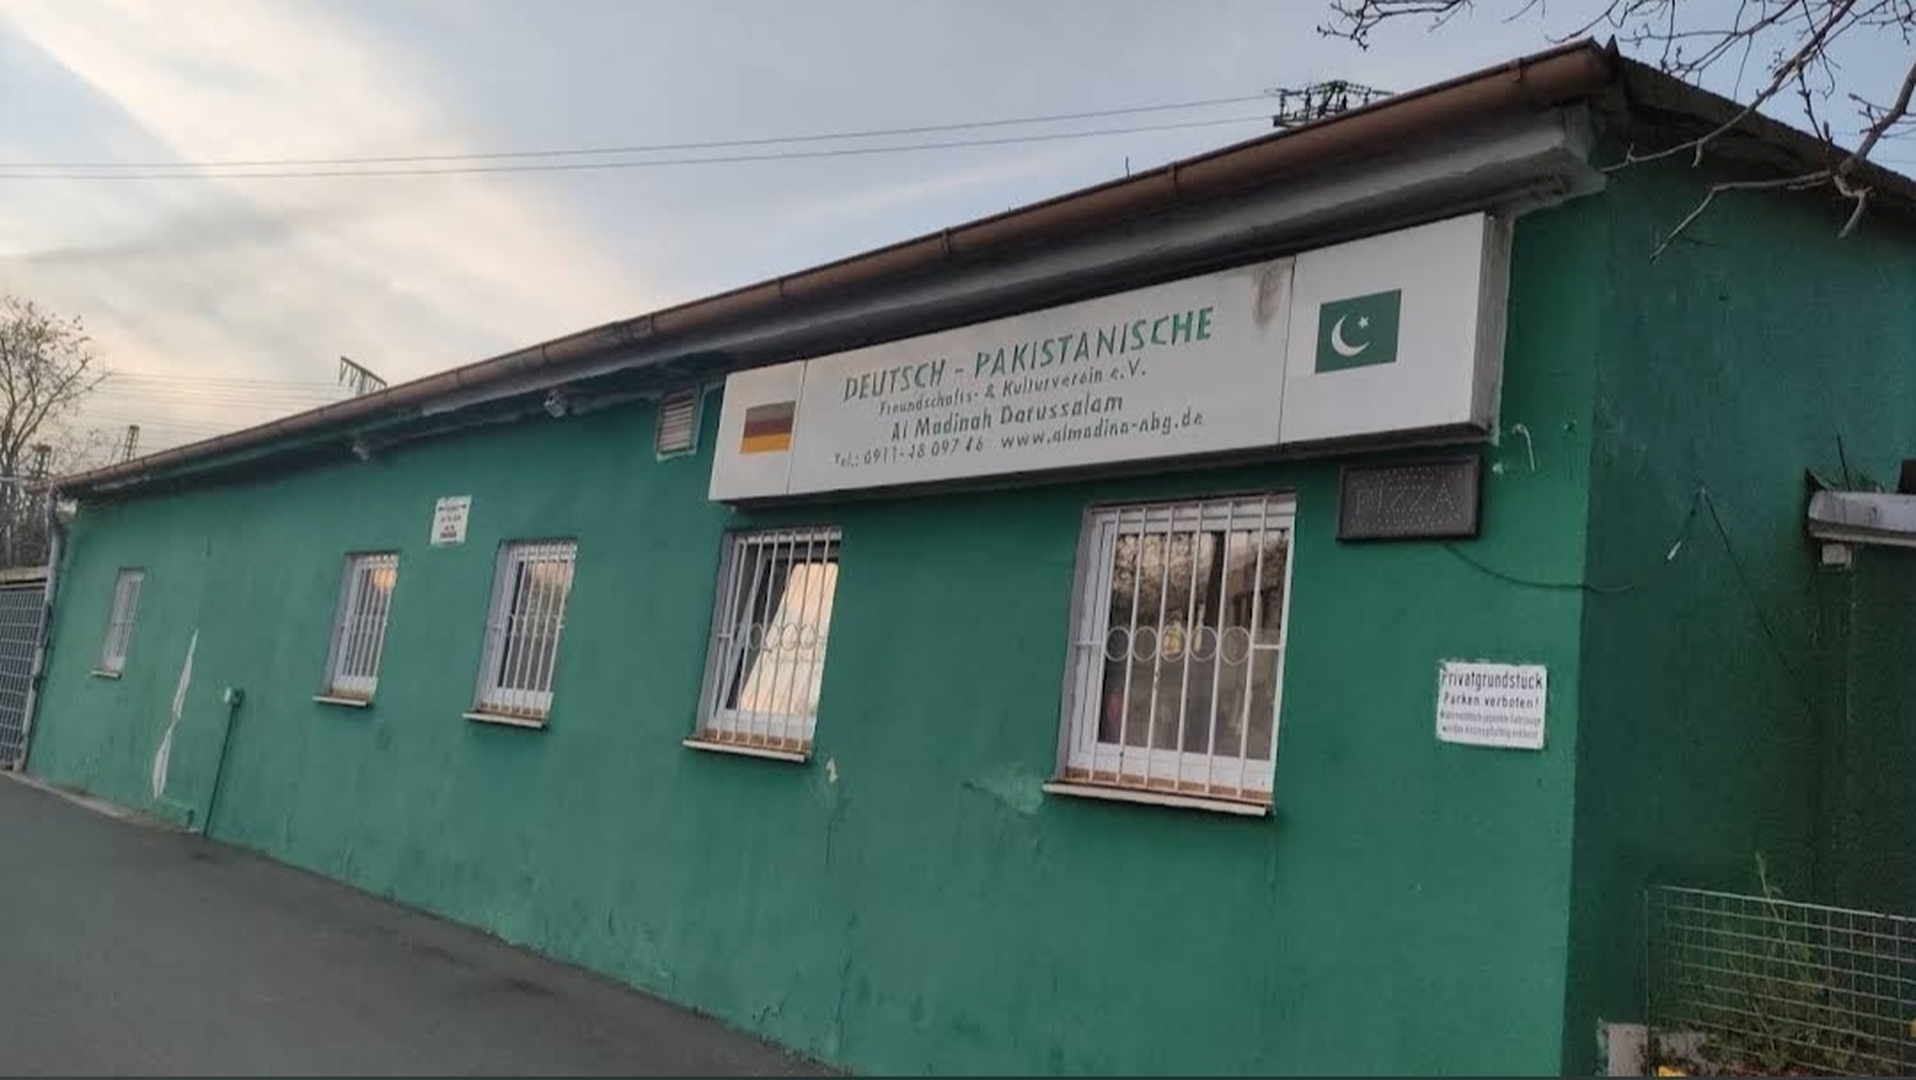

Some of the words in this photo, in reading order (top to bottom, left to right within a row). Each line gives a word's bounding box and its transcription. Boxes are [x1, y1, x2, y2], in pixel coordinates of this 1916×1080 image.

[843, 359, 945, 401] DEUTSCH
[974, 306, 1214, 379] PAKISTANISCHE
[984, 383, 995, 399] &
[891, 420, 908, 442] Al
[914, 408, 992, 439] Madinah
[1000, 391, 1124, 425] Darussalam
[1001, 406, 1204, 449] www.almadina-nbg.de
[1356, 481, 1455, 515] PIZZA
[1443, 690, 1480, 706] Parken
[1484, 694, 1539, 709] verboten!
